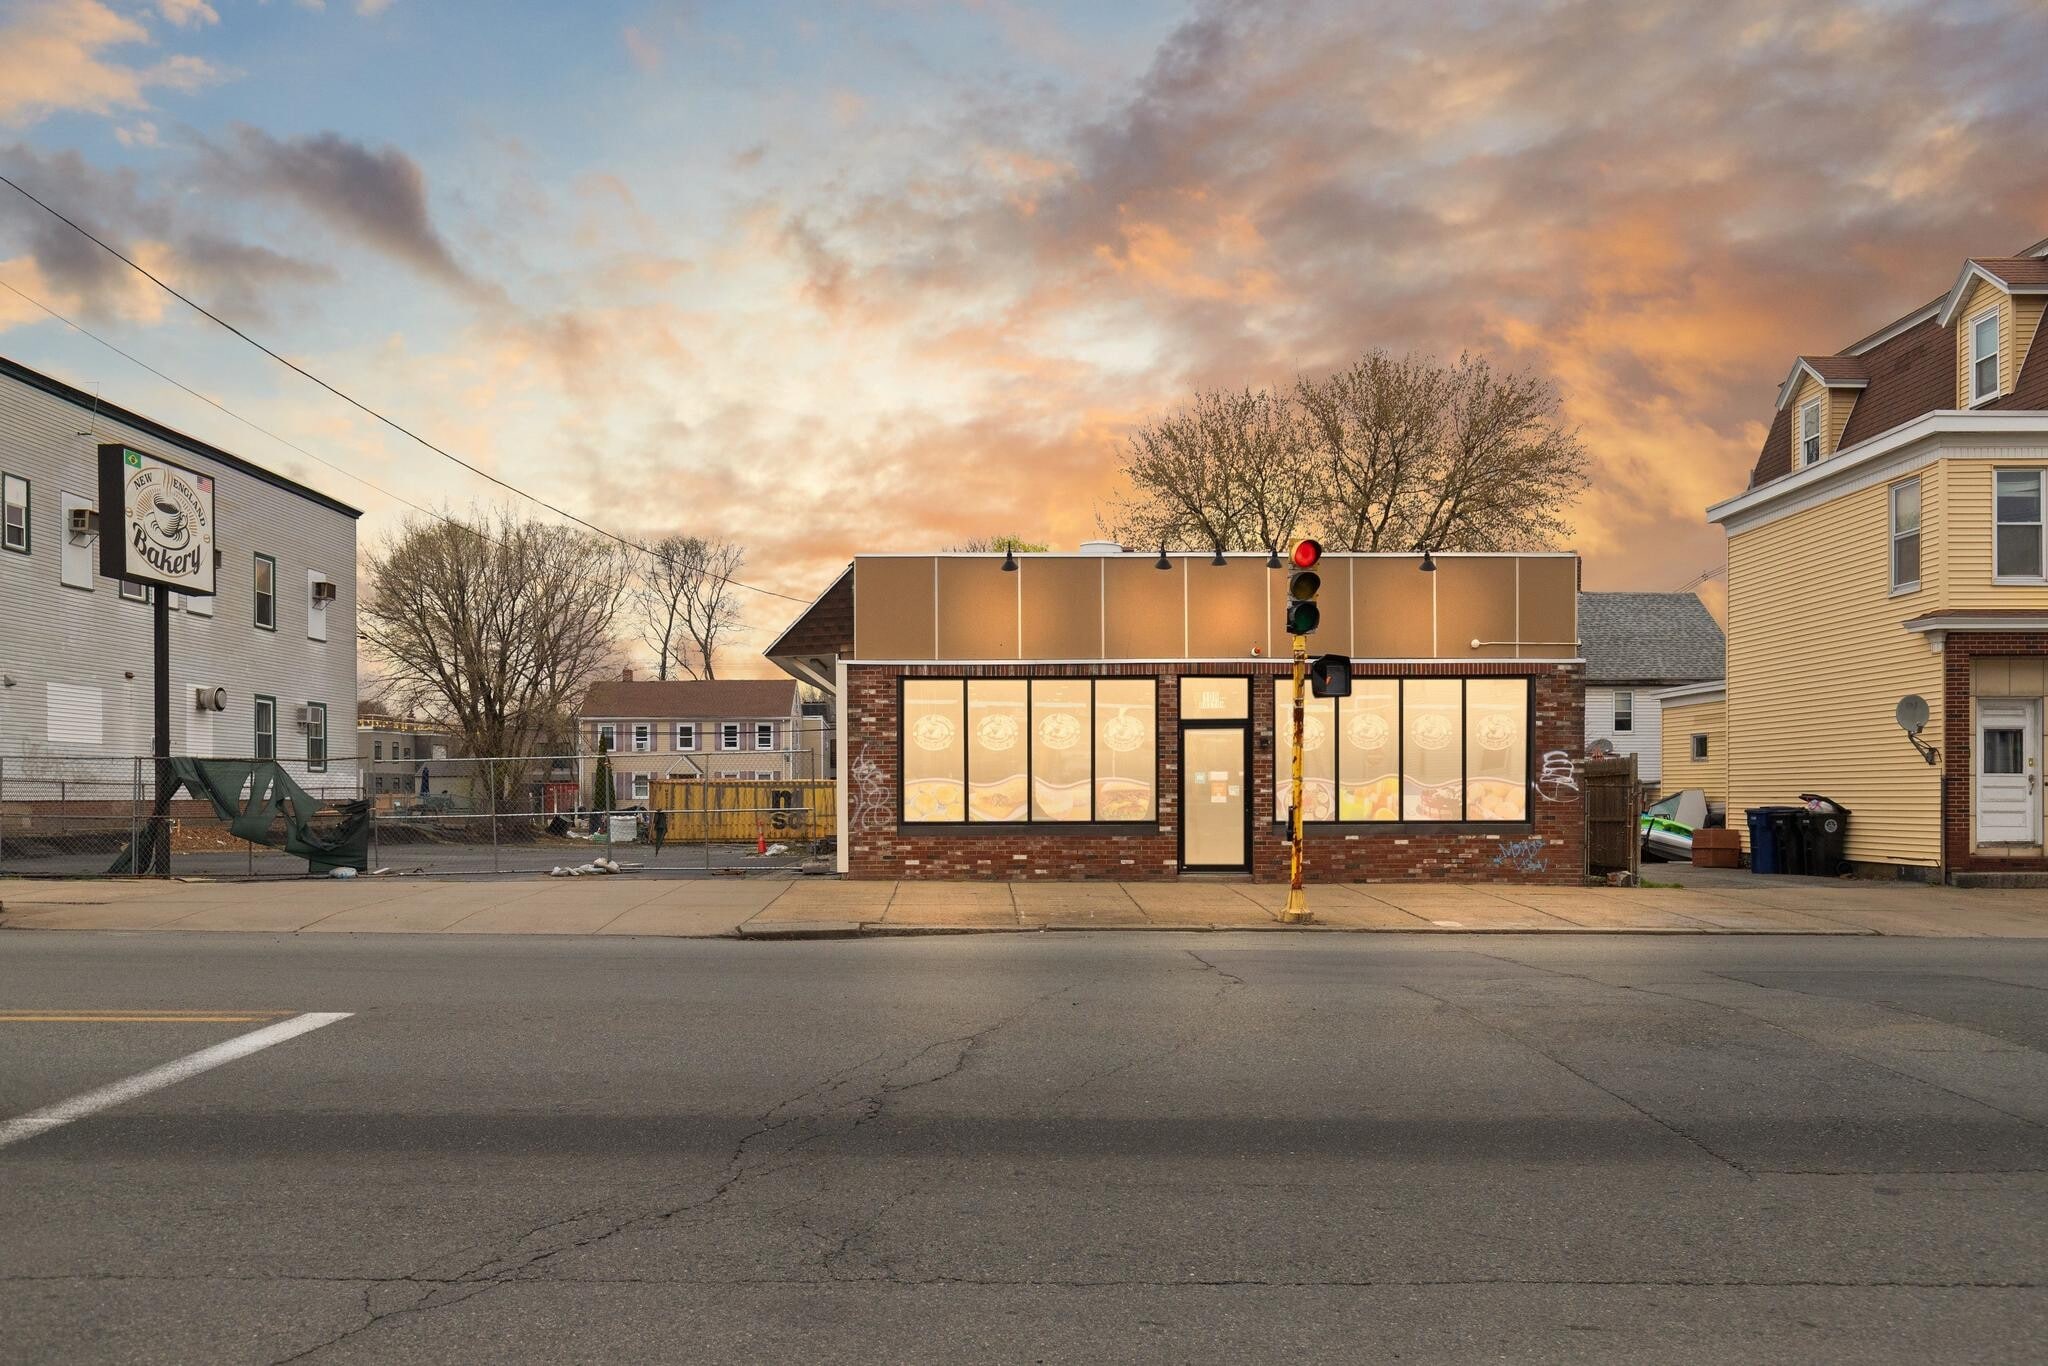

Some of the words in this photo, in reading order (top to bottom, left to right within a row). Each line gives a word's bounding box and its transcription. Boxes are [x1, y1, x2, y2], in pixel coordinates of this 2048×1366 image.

[134, 472, 152, 490] NEW
[173, 479, 205, 527] ENGLAND
[133, 522, 201, 575] Bakery
